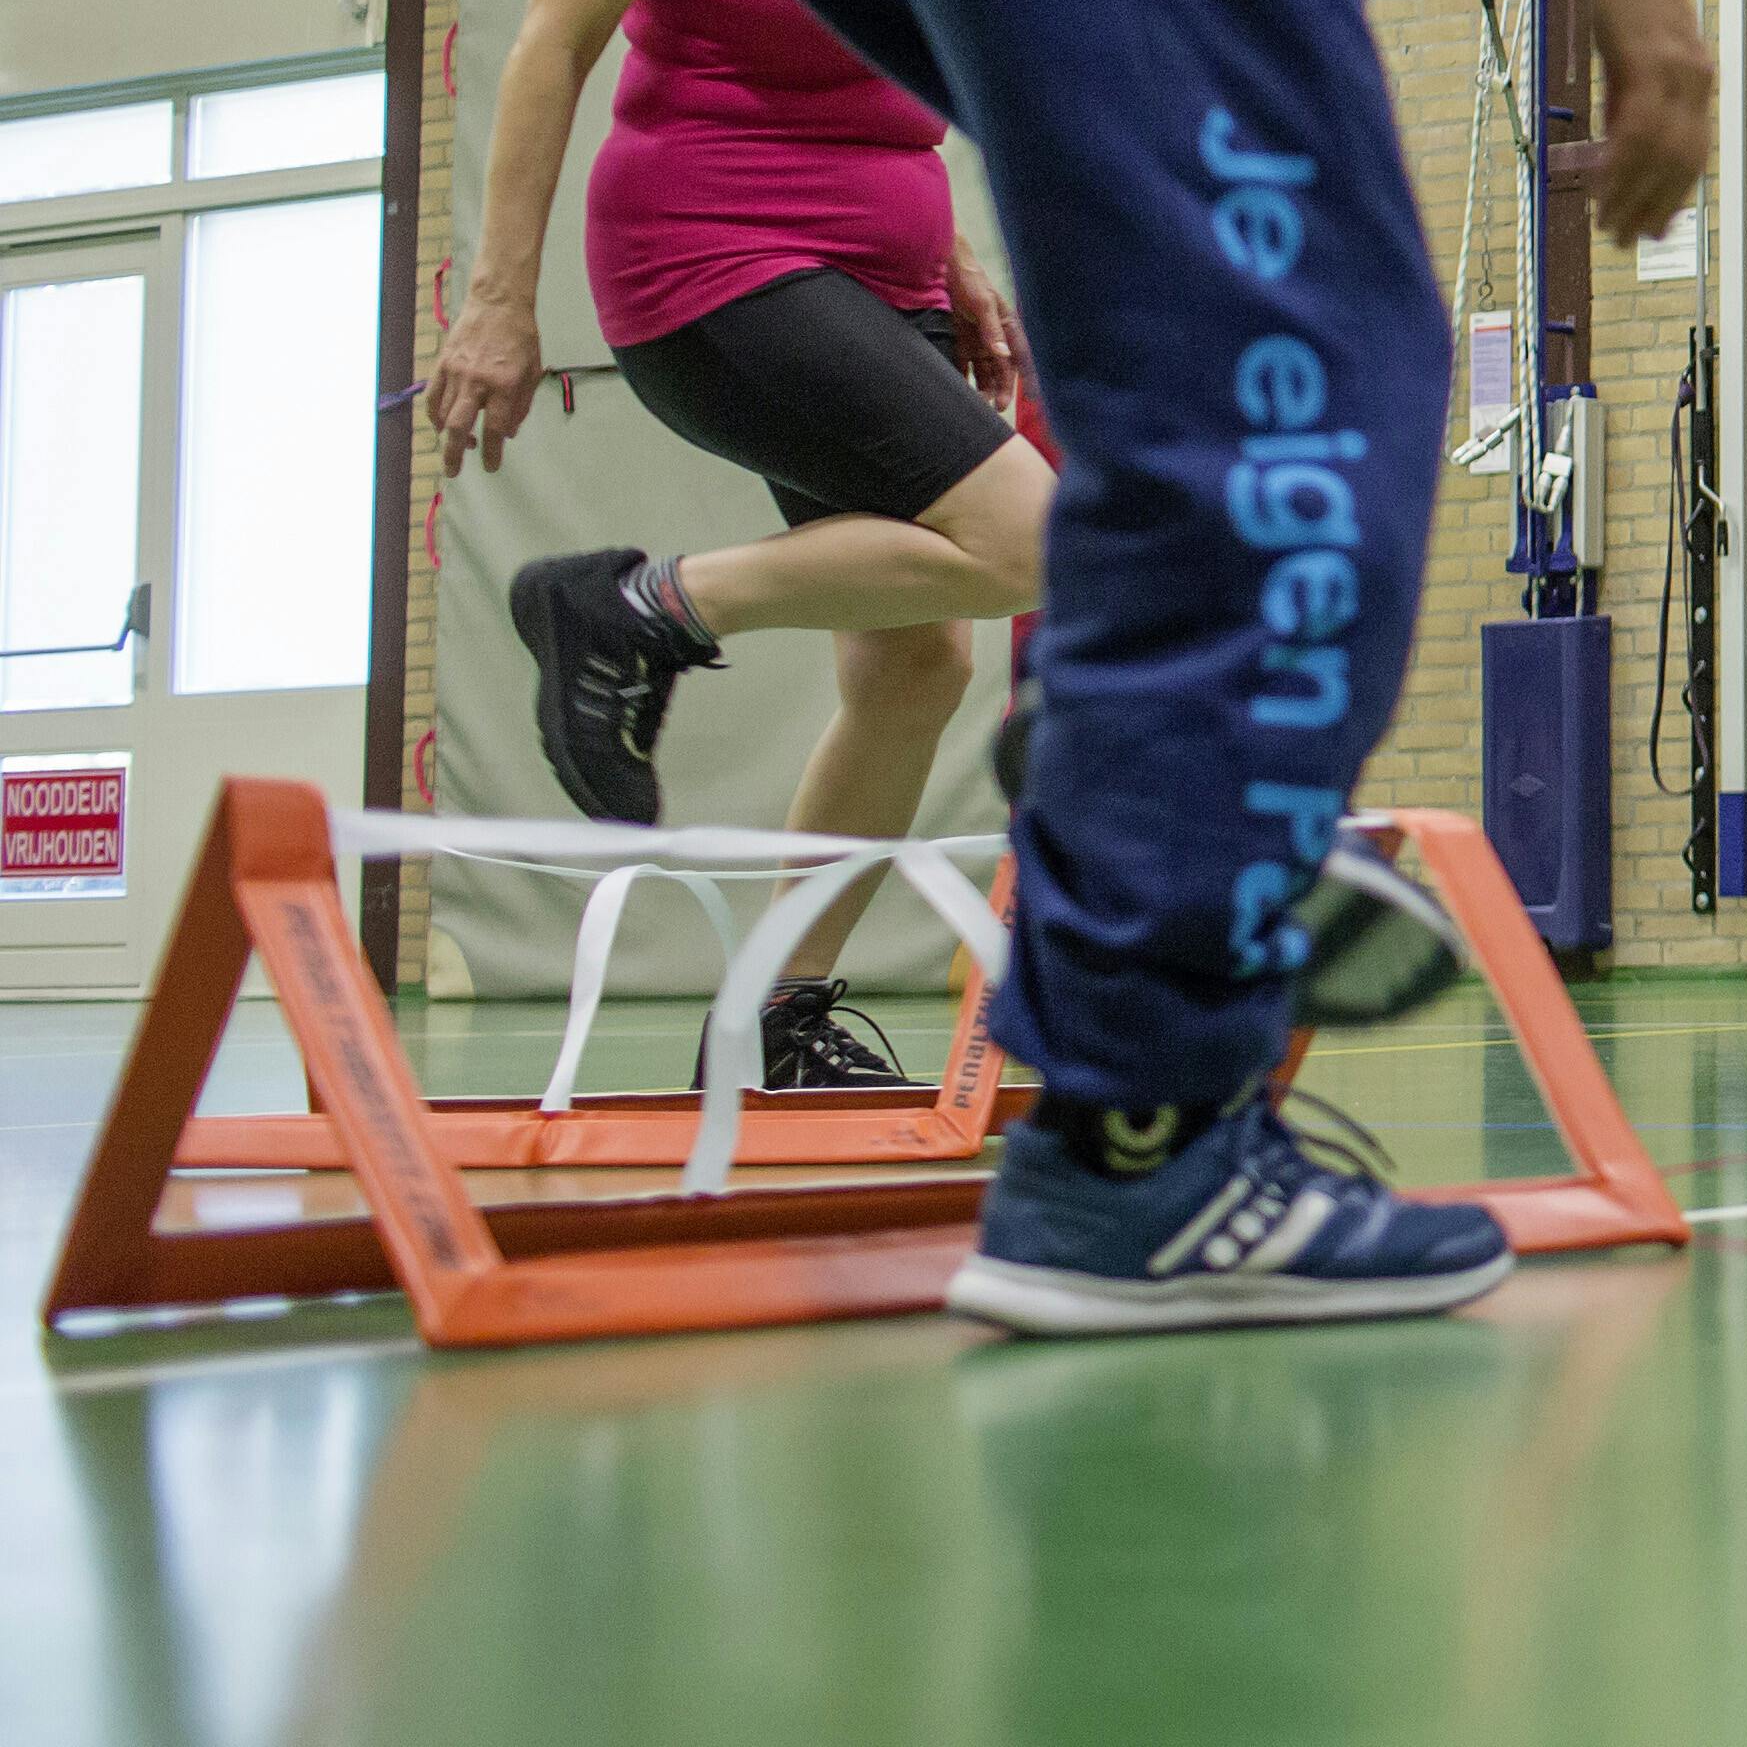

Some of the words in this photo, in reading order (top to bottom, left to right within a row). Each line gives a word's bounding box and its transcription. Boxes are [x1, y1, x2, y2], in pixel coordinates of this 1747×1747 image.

[1200, 106, 1320, 282] Je
[1226, 334, 1369, 728] eigen
[4, 828, 118, 866] VRIJHOUDEN
[6, 780, 121, 818] NOODDEUR
